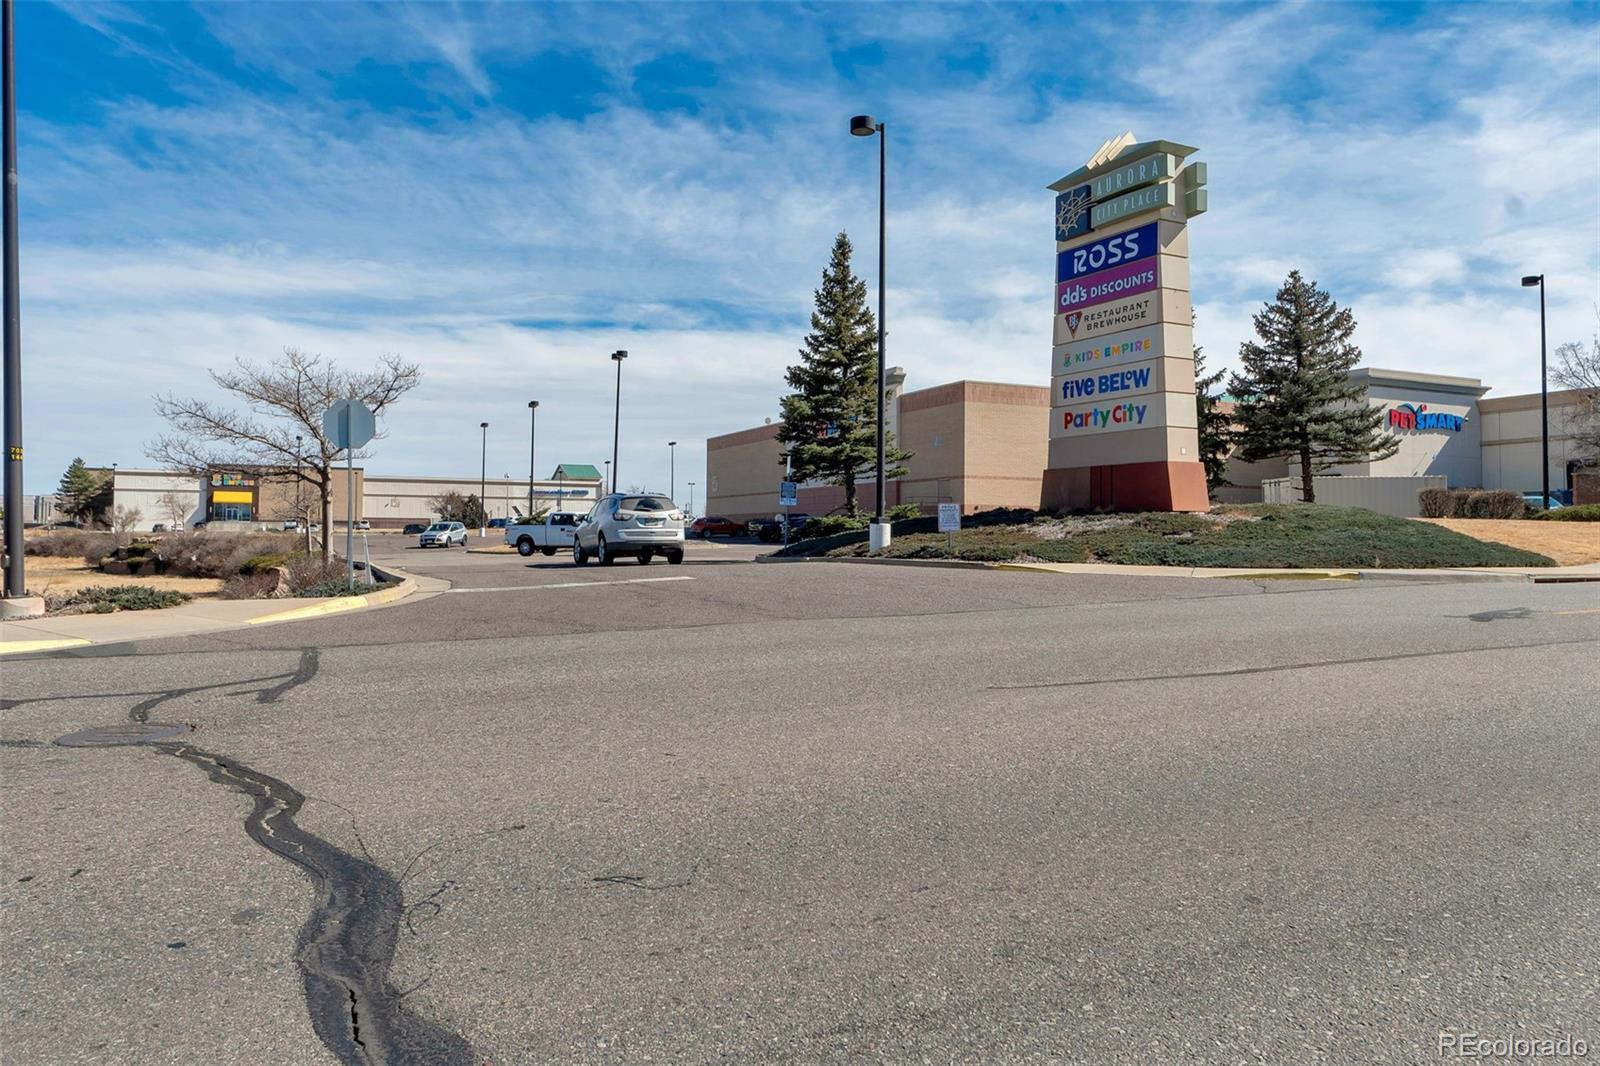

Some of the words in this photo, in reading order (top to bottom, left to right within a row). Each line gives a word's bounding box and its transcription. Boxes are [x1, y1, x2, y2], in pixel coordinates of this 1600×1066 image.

[1097, 159, 1159, 196] AURORA
[1096, 202, 1118, 221] CITY
[1123, 189, 1159, 211] PLACE
[1073, 232, 1140, 275] ROSS
[1061, 284, 1087, 307] dd's
[1090, 270, 1154, 299] DISCOUNTS
[1084, 300, 1150, 322] RESTAURANT
[1086, 310, 1147, 331] BREWHOUSE
[1075, 345, 1101, 364] KIDS
[1105, 338, 1151, 358] EMPIRE
[1062, 377, 1095, 400] five
[1098, 367, 1151, 395] BELOW
[1064, 406, 1111, 430] Party
[1112, 402, 1147, 426] City
